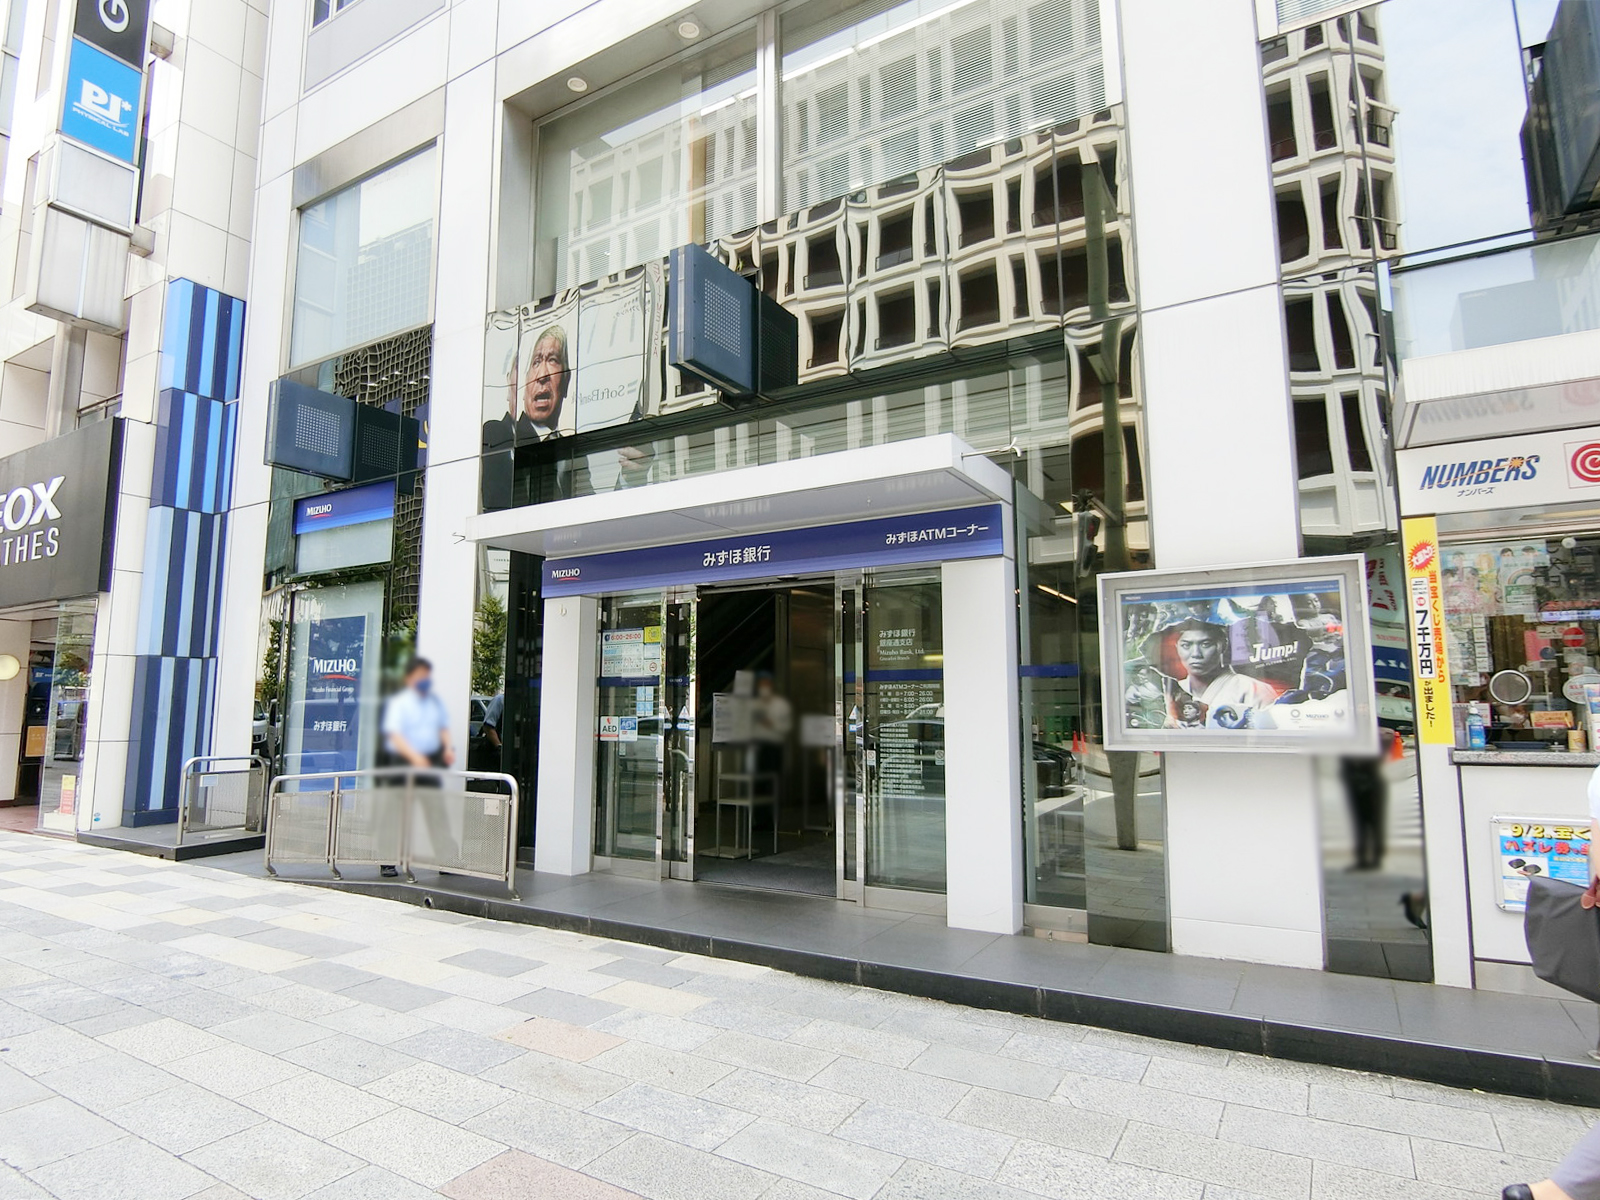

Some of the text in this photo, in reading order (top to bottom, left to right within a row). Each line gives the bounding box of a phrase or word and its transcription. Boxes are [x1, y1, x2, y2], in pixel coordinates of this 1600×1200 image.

[113, 126, 130, 137] LAB
[1419, 455, 1540, 490] NUMBERS
[1457, 487, 1494, 497] ナンバーズ
[306, 504, 332, 516] MIZUHO
[885, 523, 989, 545] みずほATMコーナー
[703, 546, 771, 567] みずほ銀行
[552, 568, 580, 579] MIZUHO
[879, 629, 916, 638] みずほ銀行
[1249, 640, 1298, 663] Jump!
[312, 658, 356, 673] MIZUHO
[313, 721, 347, 732] みずほ銀行
[602, 725, 618, 733] AED
